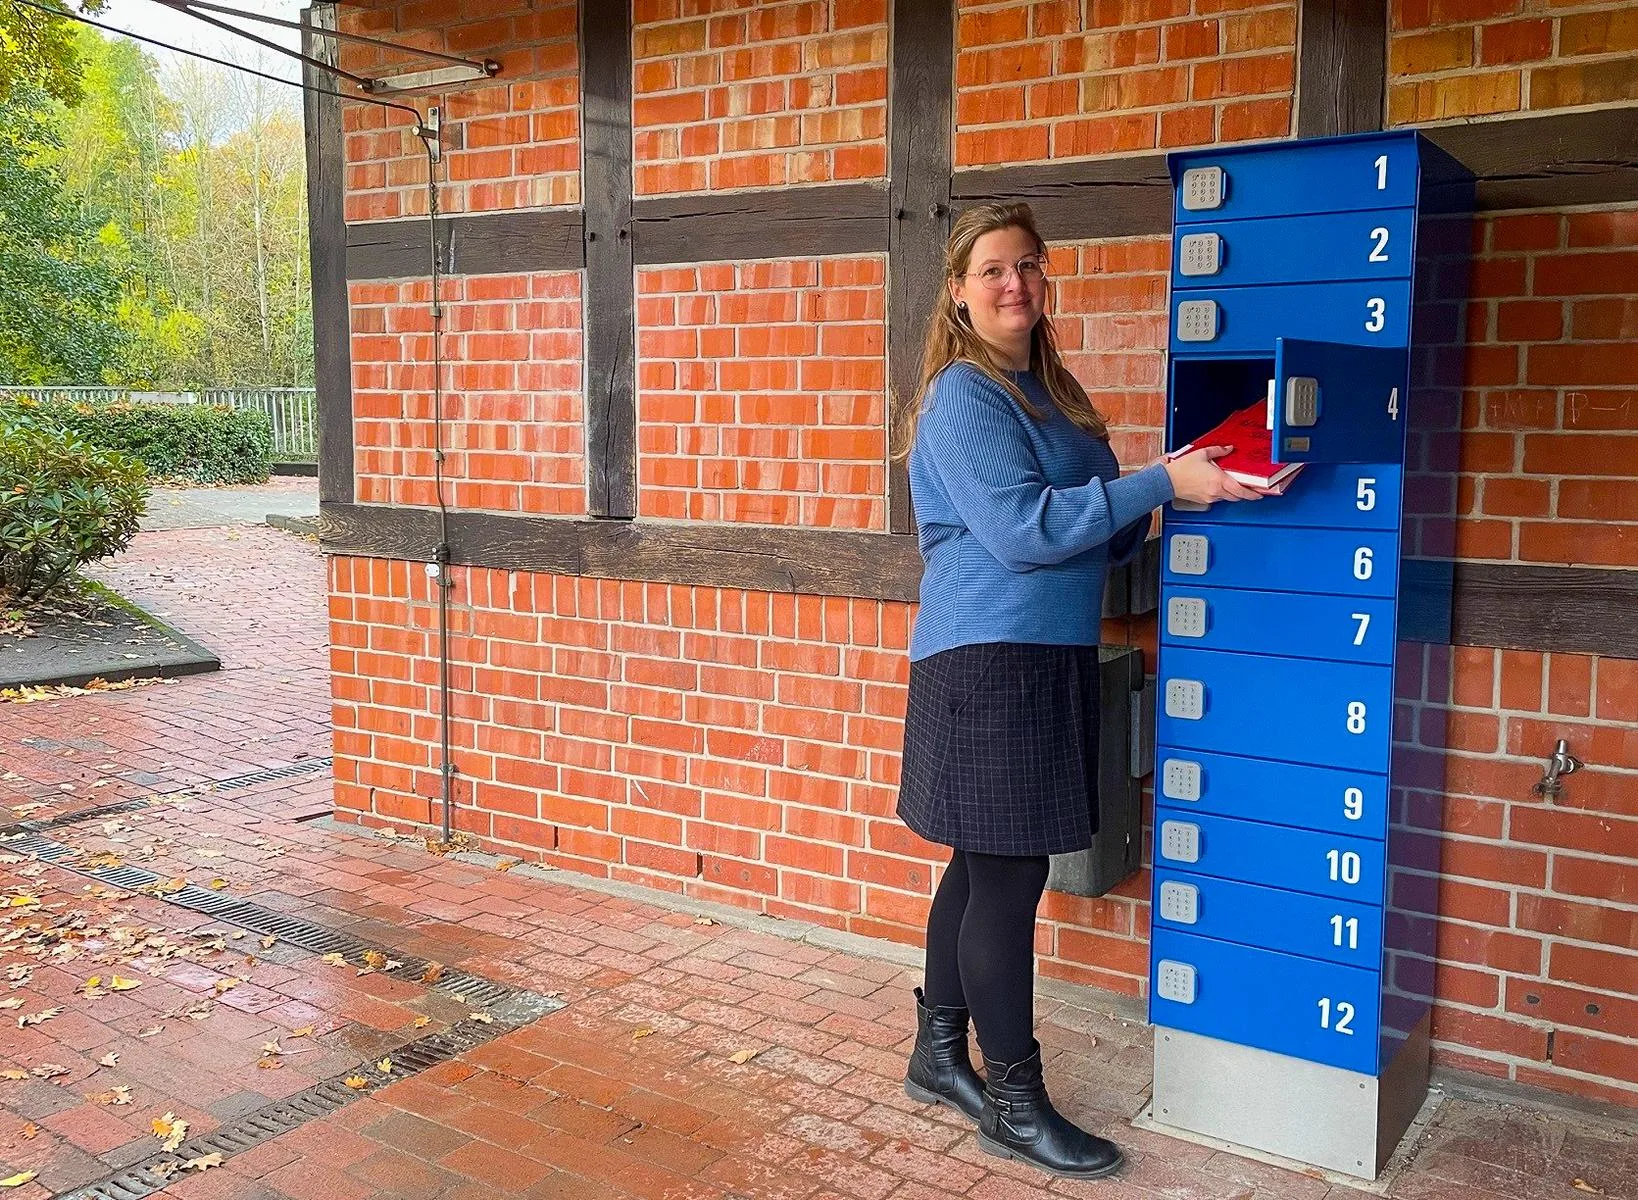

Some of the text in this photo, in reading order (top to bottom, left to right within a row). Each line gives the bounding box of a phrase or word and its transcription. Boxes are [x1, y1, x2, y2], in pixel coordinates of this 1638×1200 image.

[1375, 156, 1388, 190] 1
[1368, 228, 1389, 262] 2
[1365, 297, 1385, 332] 3
[1387, 387, 1399, 421] 4
[1356, 478, 1376, 511] 5
[1353, 547, 1373, 580] 6
[1351, 613, 1370, 646] 7
[1346, 701, 1366, 734] 8
[1343, 787, 1363, 820] 9
[1326, 849, 1361, 884] 10
[1330, 914, 1358, 949] 11
[1318, 997, 1355, 1035] 12
